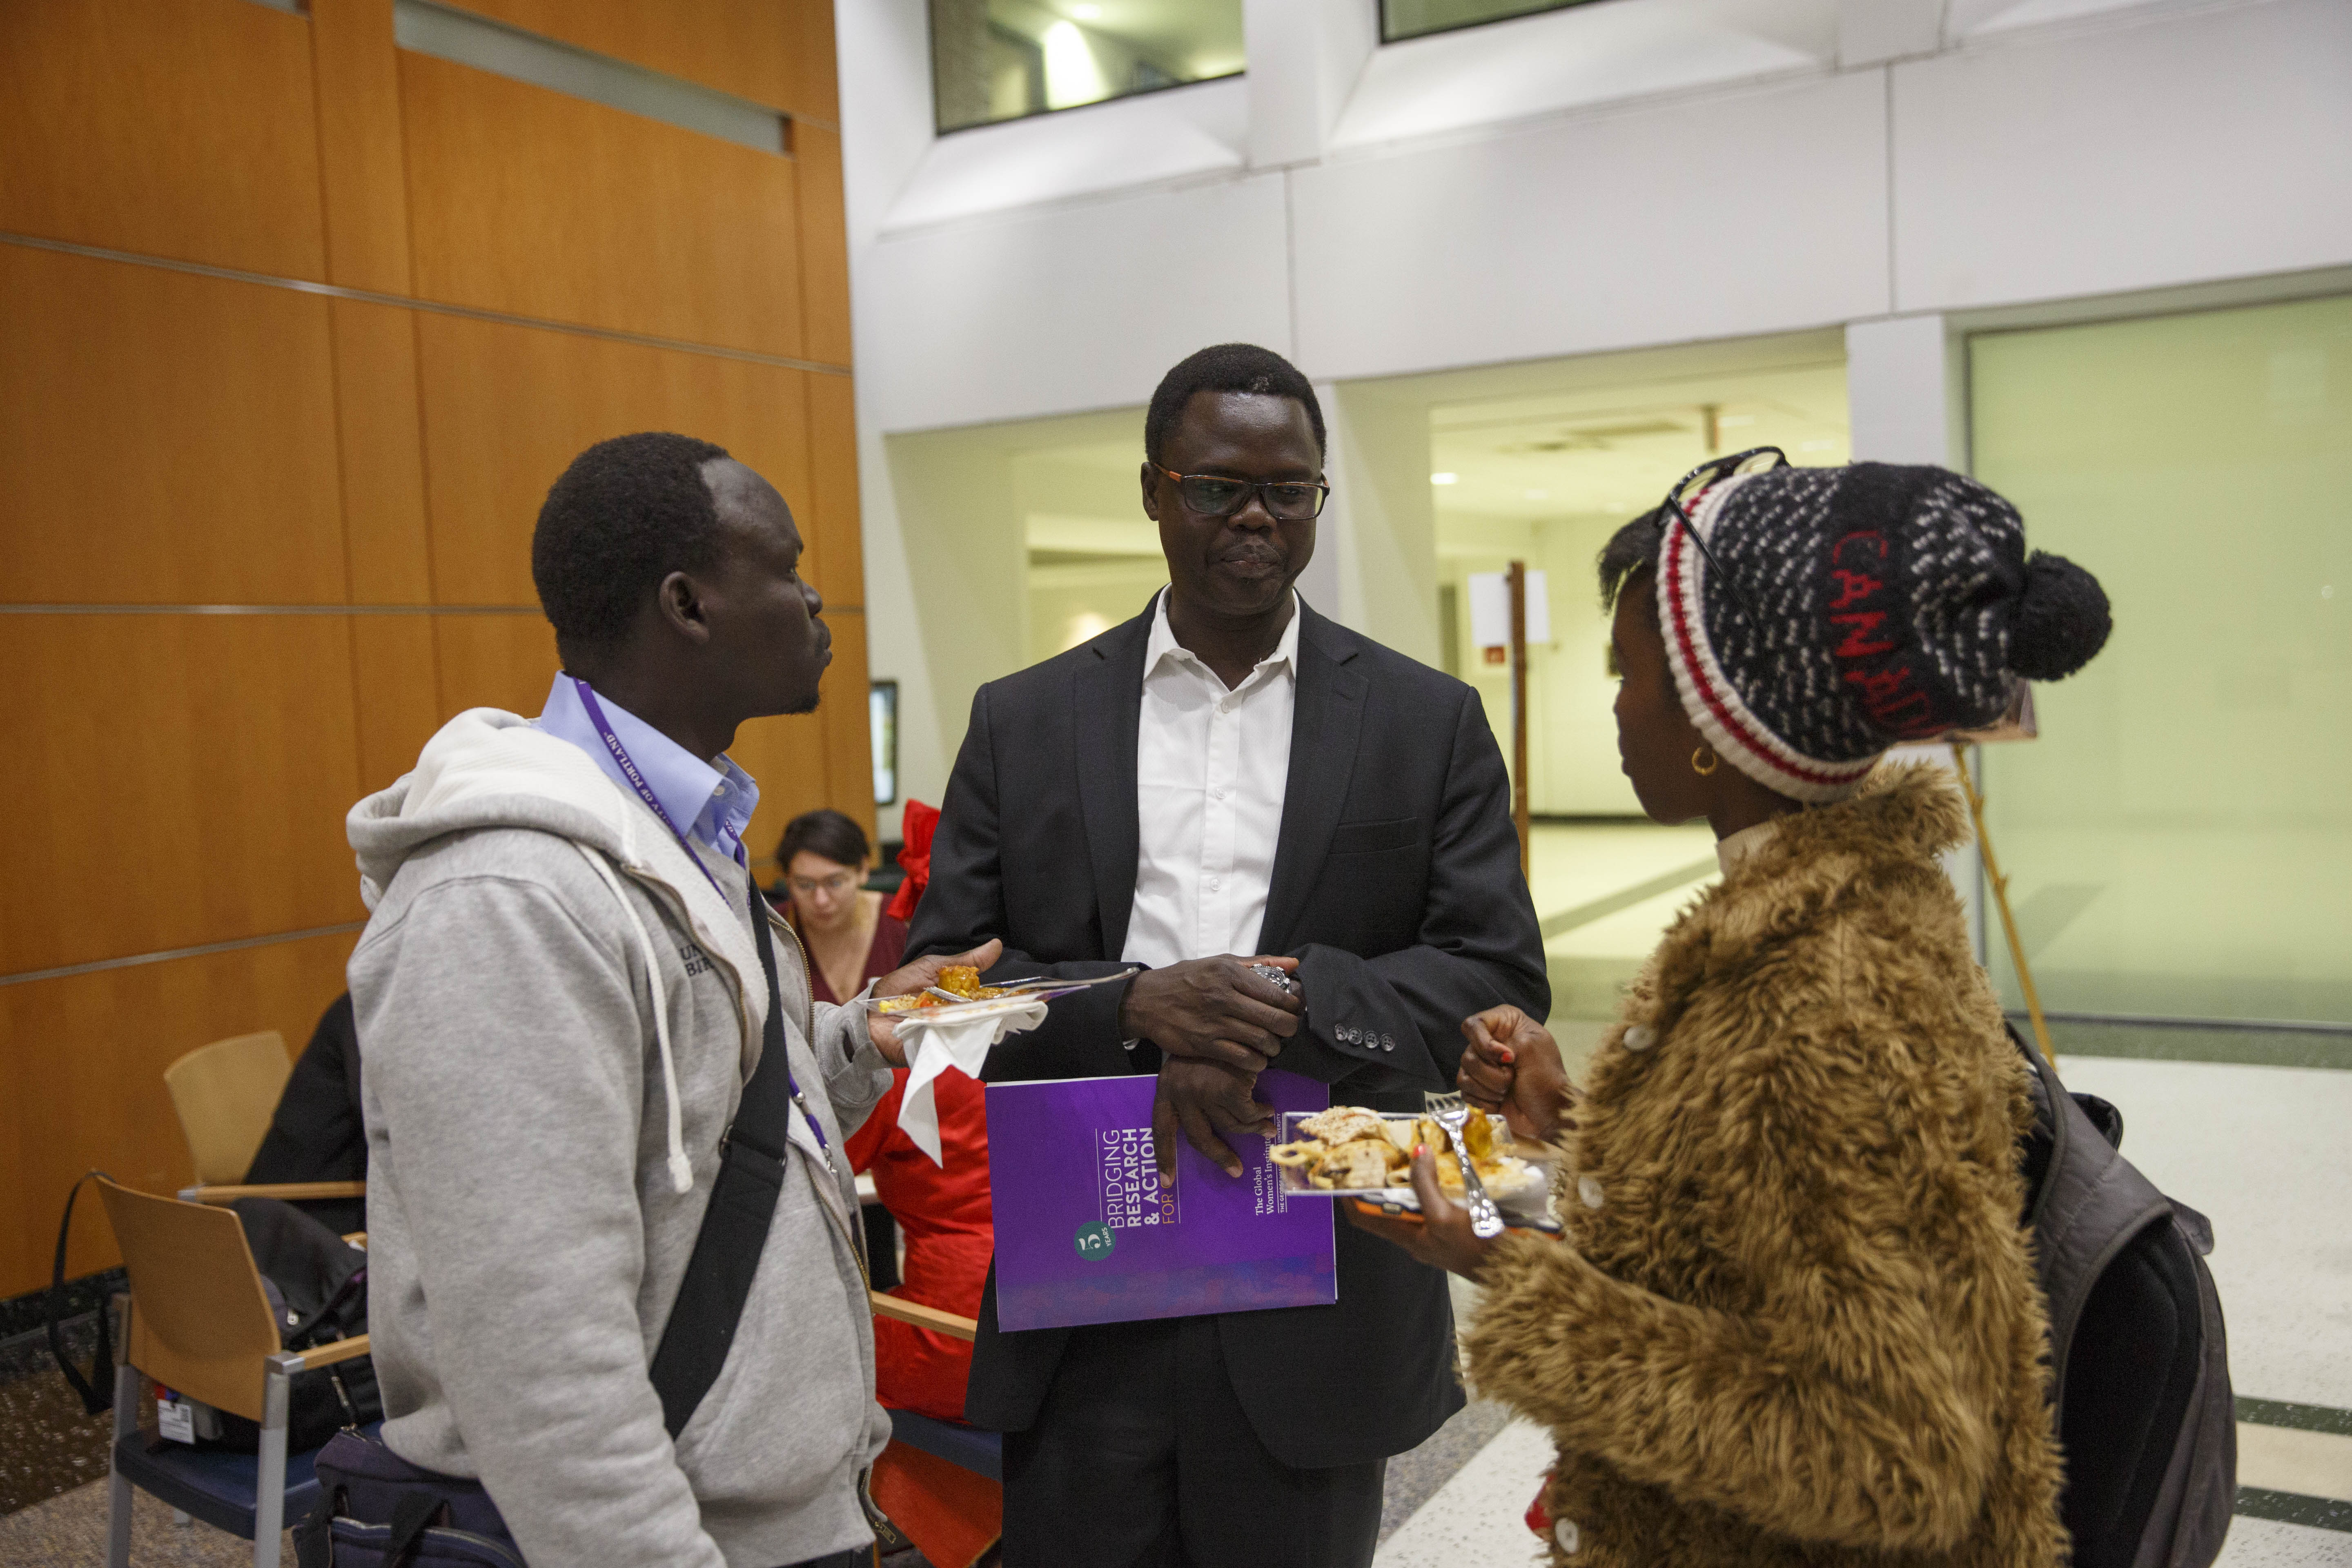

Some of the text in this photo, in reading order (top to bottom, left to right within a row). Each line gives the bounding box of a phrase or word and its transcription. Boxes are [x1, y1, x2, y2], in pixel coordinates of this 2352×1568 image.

[640, 789, 653, 802] OF
[1103, 1129, 1125, 1228] BRIDGING
[1122, 1129, 1142, 1227] RESEARCH
[1139, 1127, 1160, 1225] & ACTION
[1253, 1166, 1263, 1216] The Global
[1264, 1174, 1274, 1214] Women's
[1161, 1194, 1175, 1224] FOR
[1078, 1234, 1101, 1250] 5
[1102, 1227, 1111, 1246] YEARS
